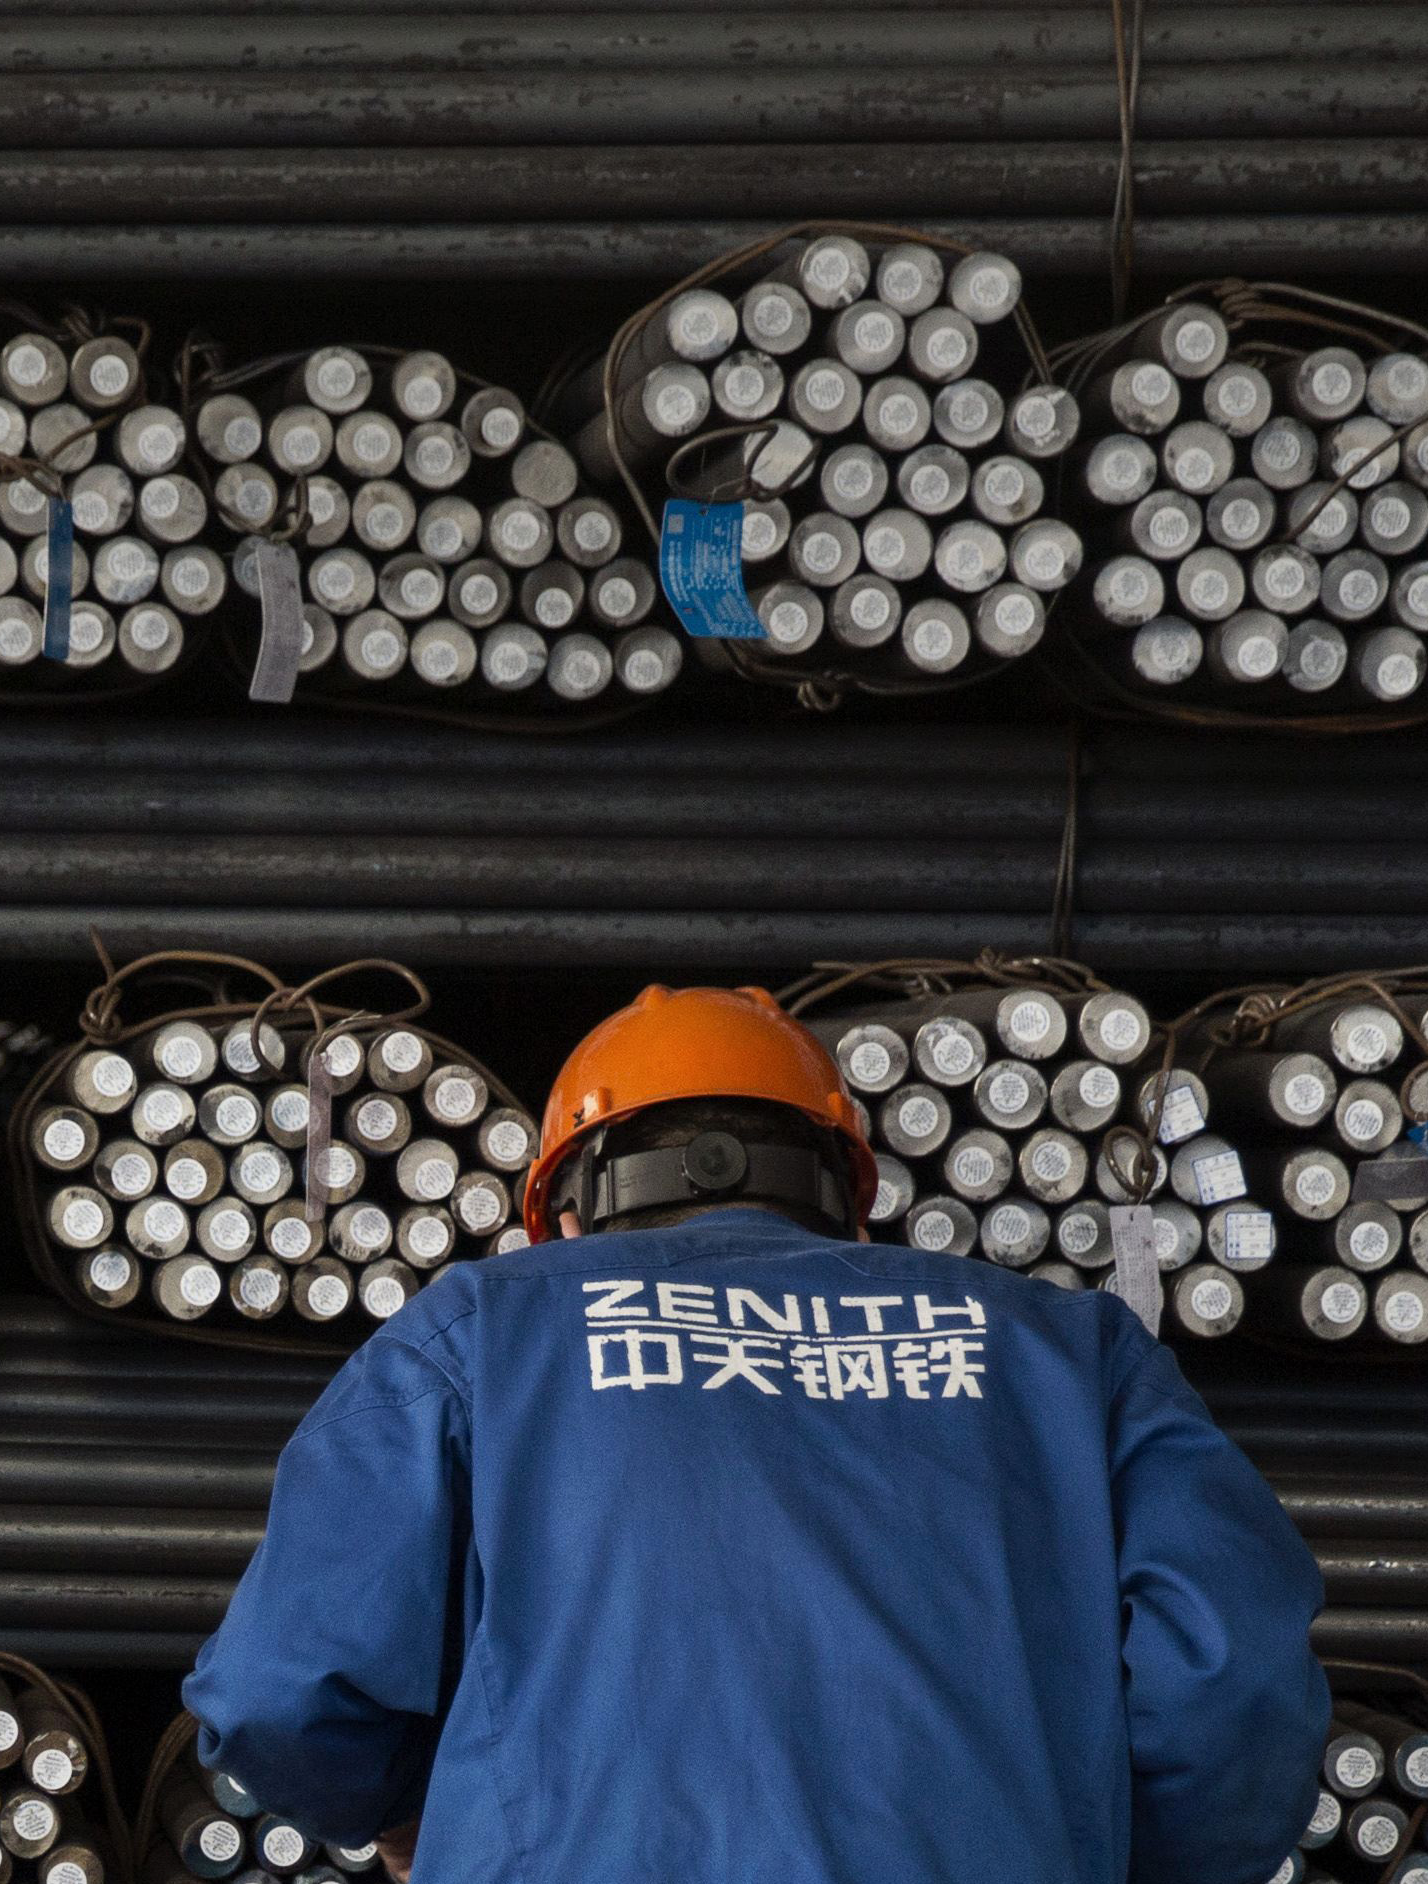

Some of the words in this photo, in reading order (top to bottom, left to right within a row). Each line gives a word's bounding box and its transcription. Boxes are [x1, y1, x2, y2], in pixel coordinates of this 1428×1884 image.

[582, 1280, 987, 1334] ZENITH
[587, 1329, 986, 1400] 中天钢铁
